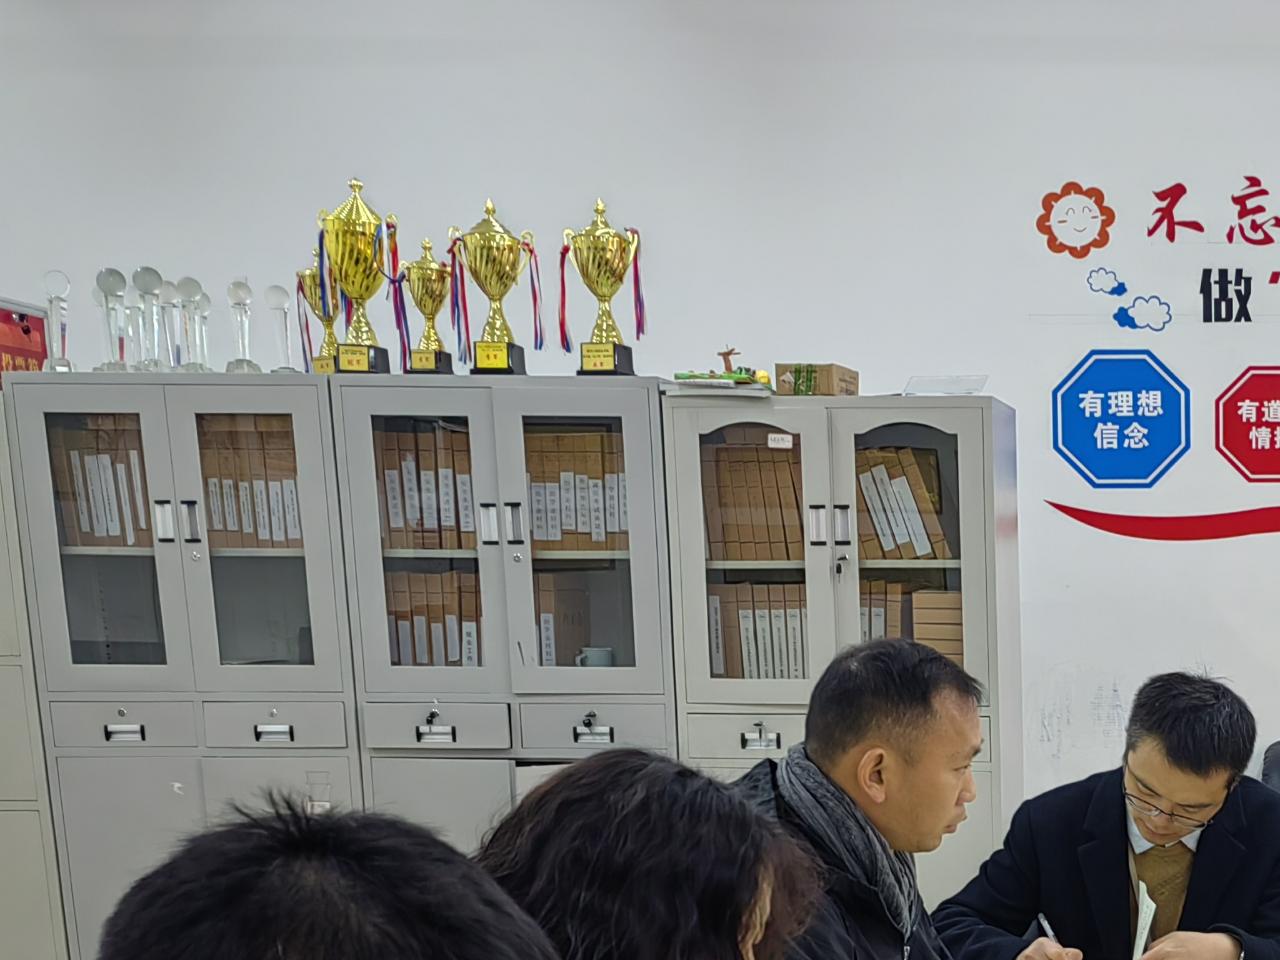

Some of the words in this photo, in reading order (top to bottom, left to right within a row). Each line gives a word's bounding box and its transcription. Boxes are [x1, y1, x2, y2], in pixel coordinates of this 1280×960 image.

[1079, 390, 1164, 418] 有理想
[1093, 421, 1150, 449] 信念
